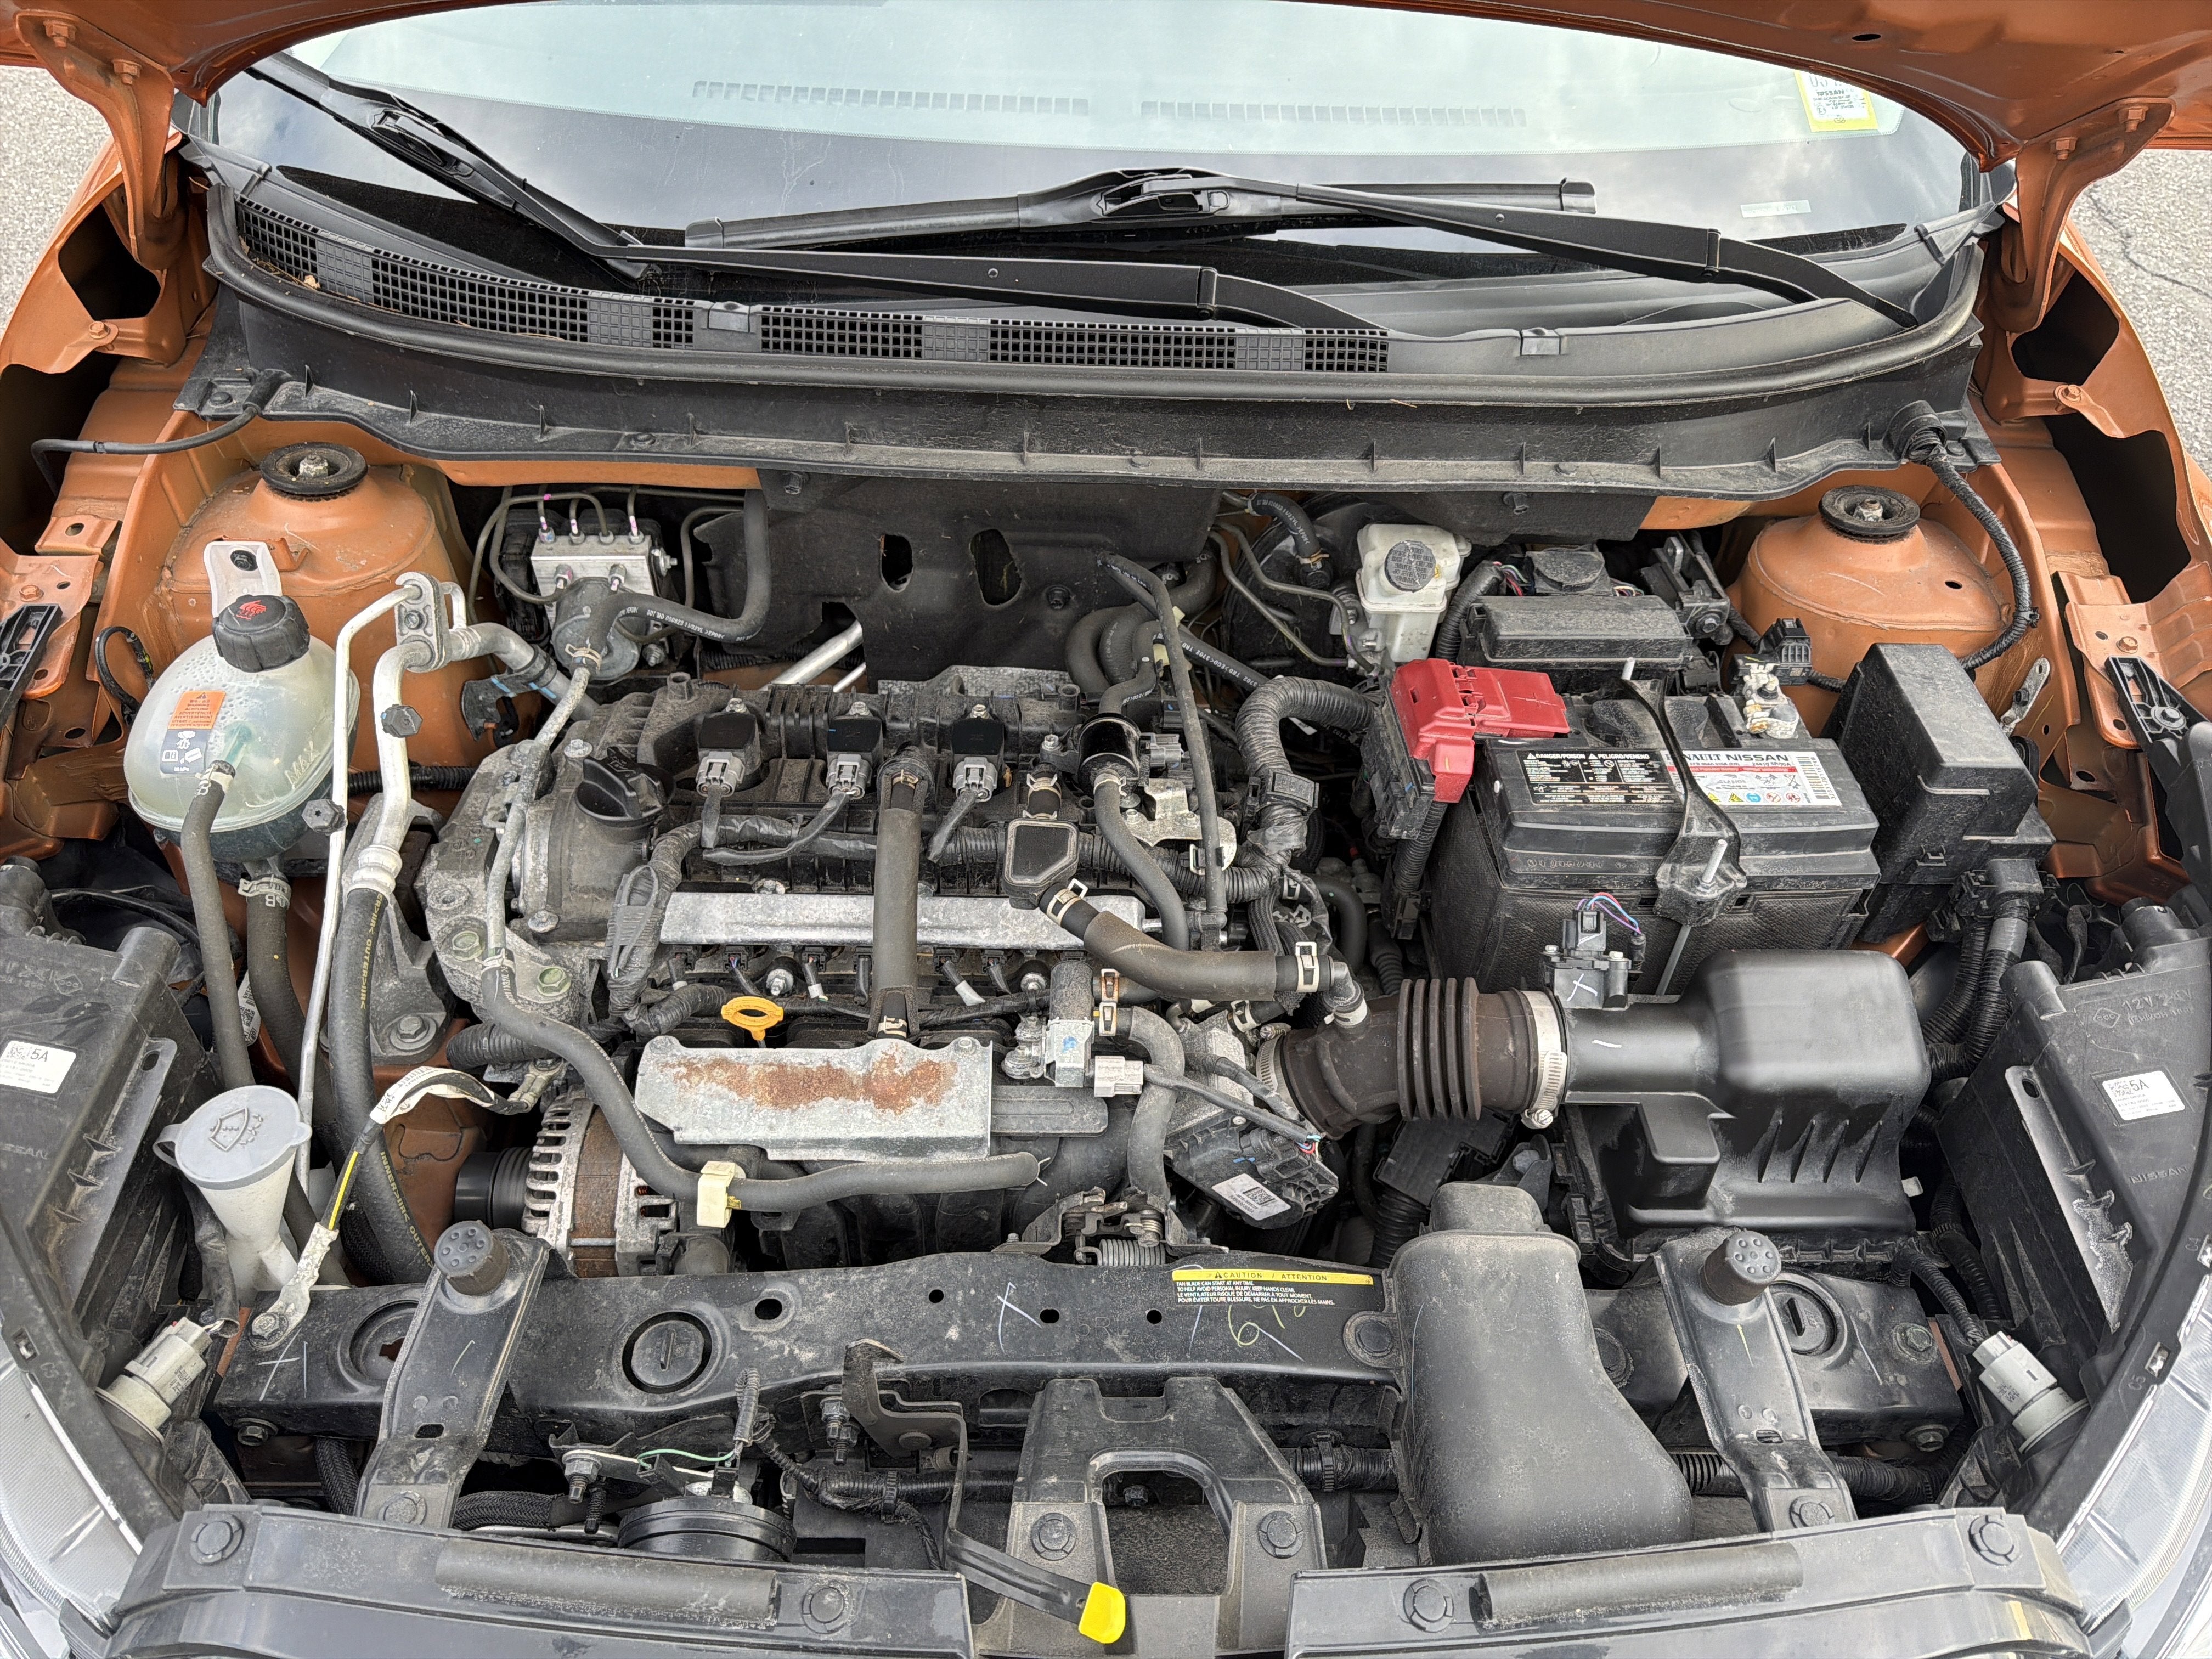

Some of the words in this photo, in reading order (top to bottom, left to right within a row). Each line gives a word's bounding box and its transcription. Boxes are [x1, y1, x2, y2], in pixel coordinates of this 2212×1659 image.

[646, 609, 656, 617] DOT
[1666, 753, 1722, 761] RNAULT
[284, 741, 317, 790] MAX
[360, 939, 373, 1009] OUTER>IIR<
[30, 1048, 49, 1063] 5A
[2129, 1079, 2149, 1091] 5A
[2129, 1166, 2189, 1184] NISSAN
[380, 1151, 410, 1222] INNER>IIR<
